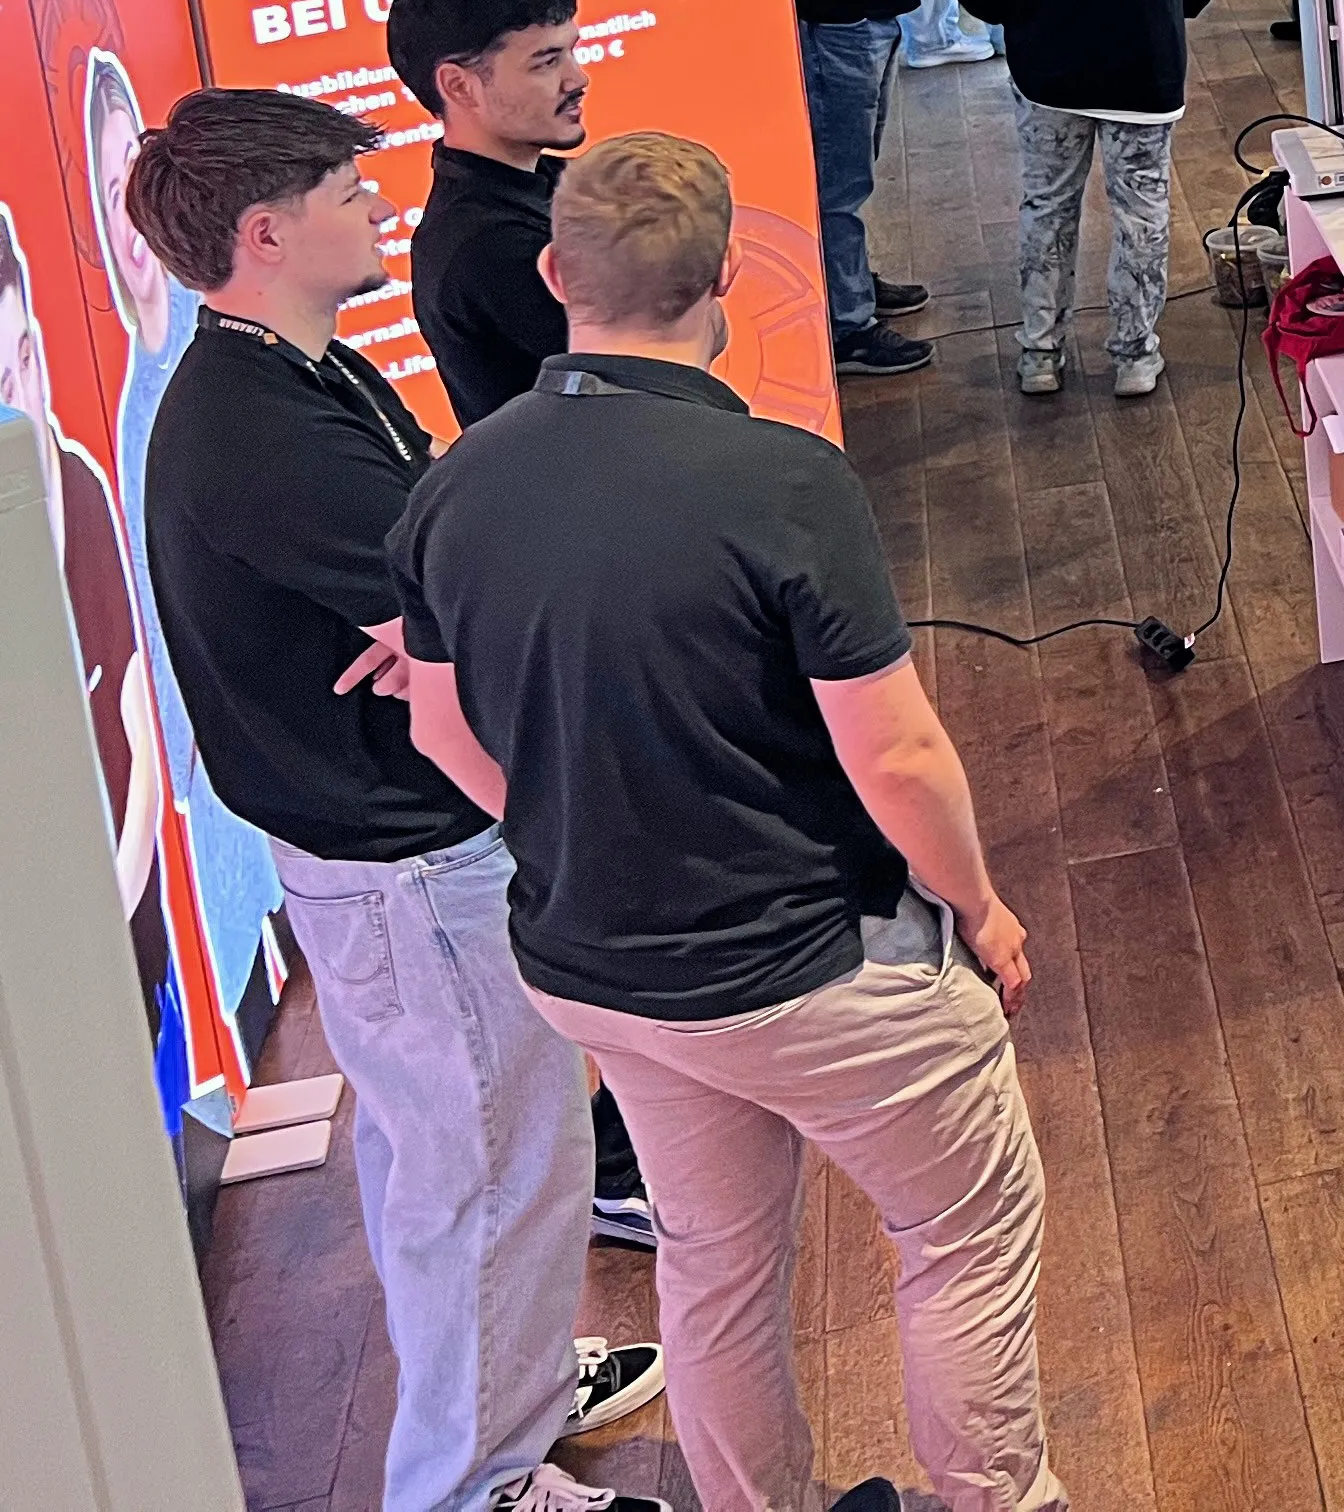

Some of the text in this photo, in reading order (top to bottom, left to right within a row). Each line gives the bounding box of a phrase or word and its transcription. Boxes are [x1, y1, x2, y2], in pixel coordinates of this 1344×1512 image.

[580, 10, 656, 41] natlich
[574, 42, 624, 65] 00 €
